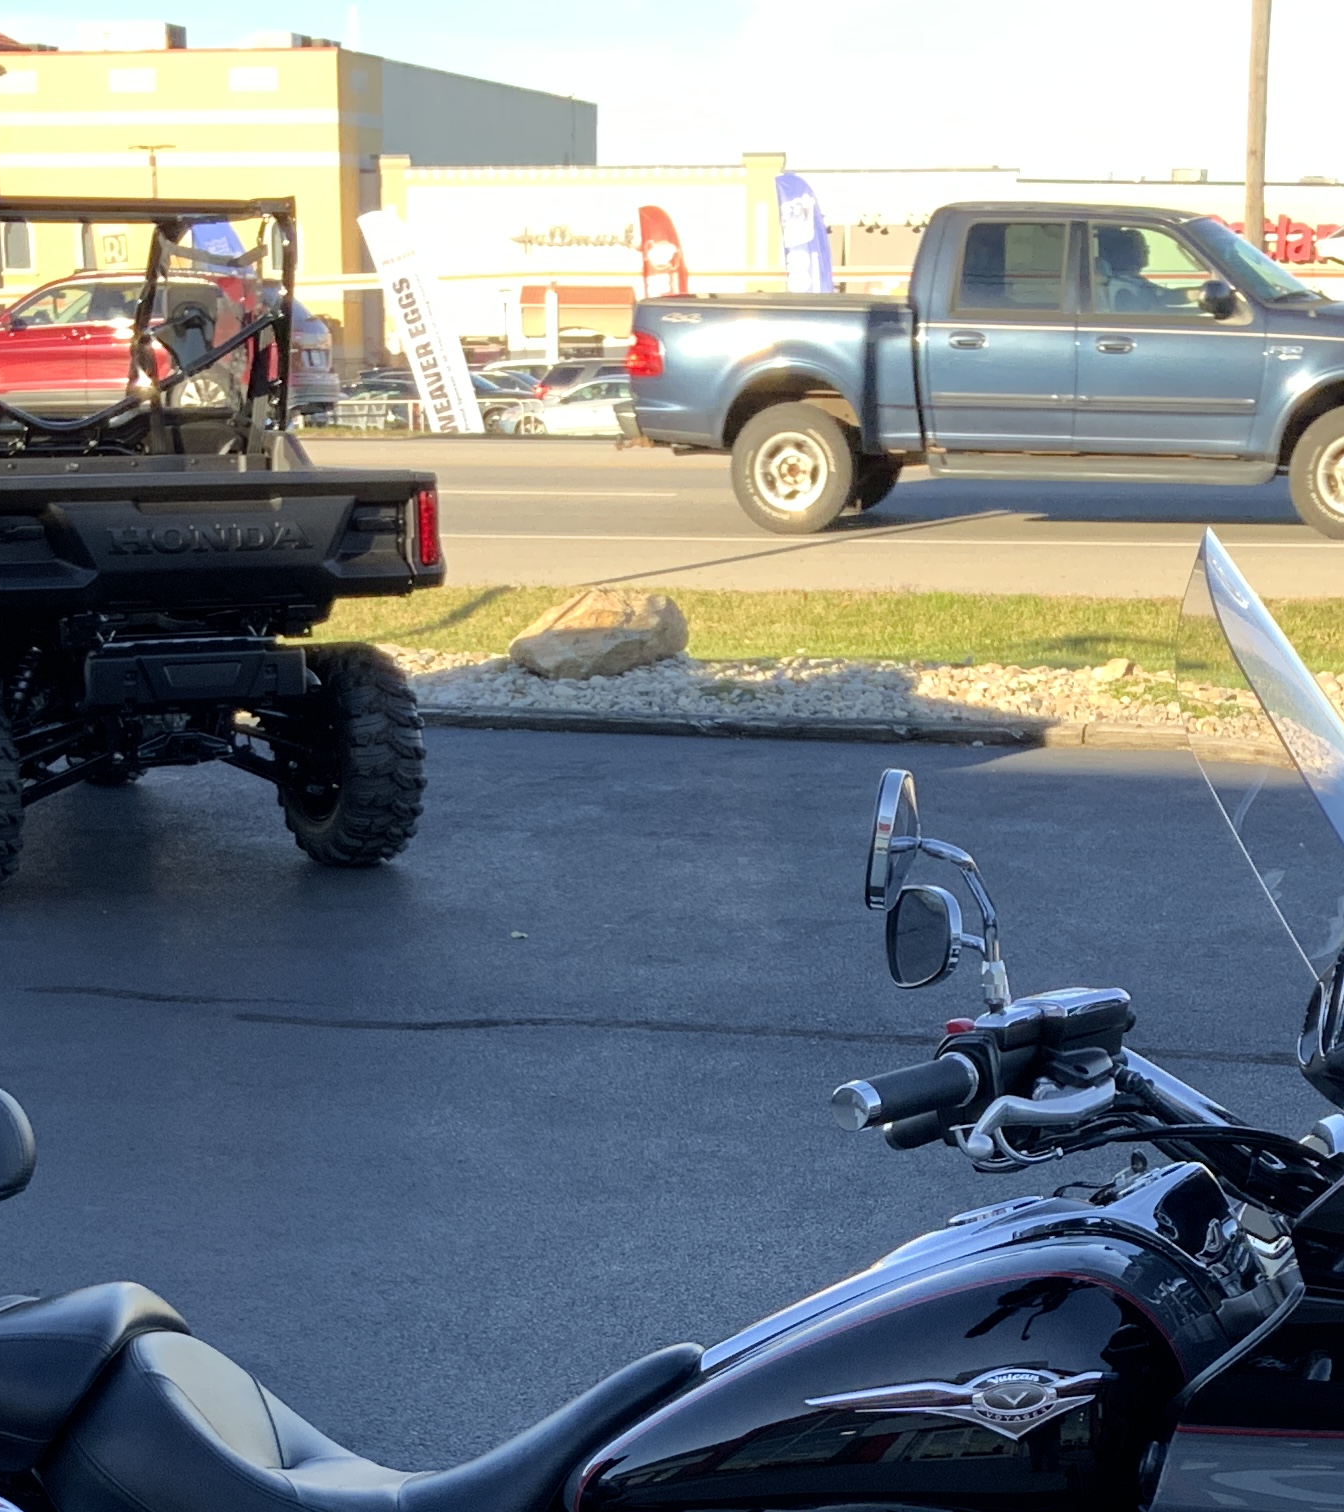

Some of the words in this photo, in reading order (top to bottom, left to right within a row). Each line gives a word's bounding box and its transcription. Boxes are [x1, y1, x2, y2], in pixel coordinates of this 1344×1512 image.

[392, 277, 426, 339] EGGS
[416, 341, 459, 433] WEAVER
[106, 521, 314, 555] HONDA
[986, 1372, 1040, 1384] Vulcan
[985, 1406, 1048, 1422] VOYAGER
